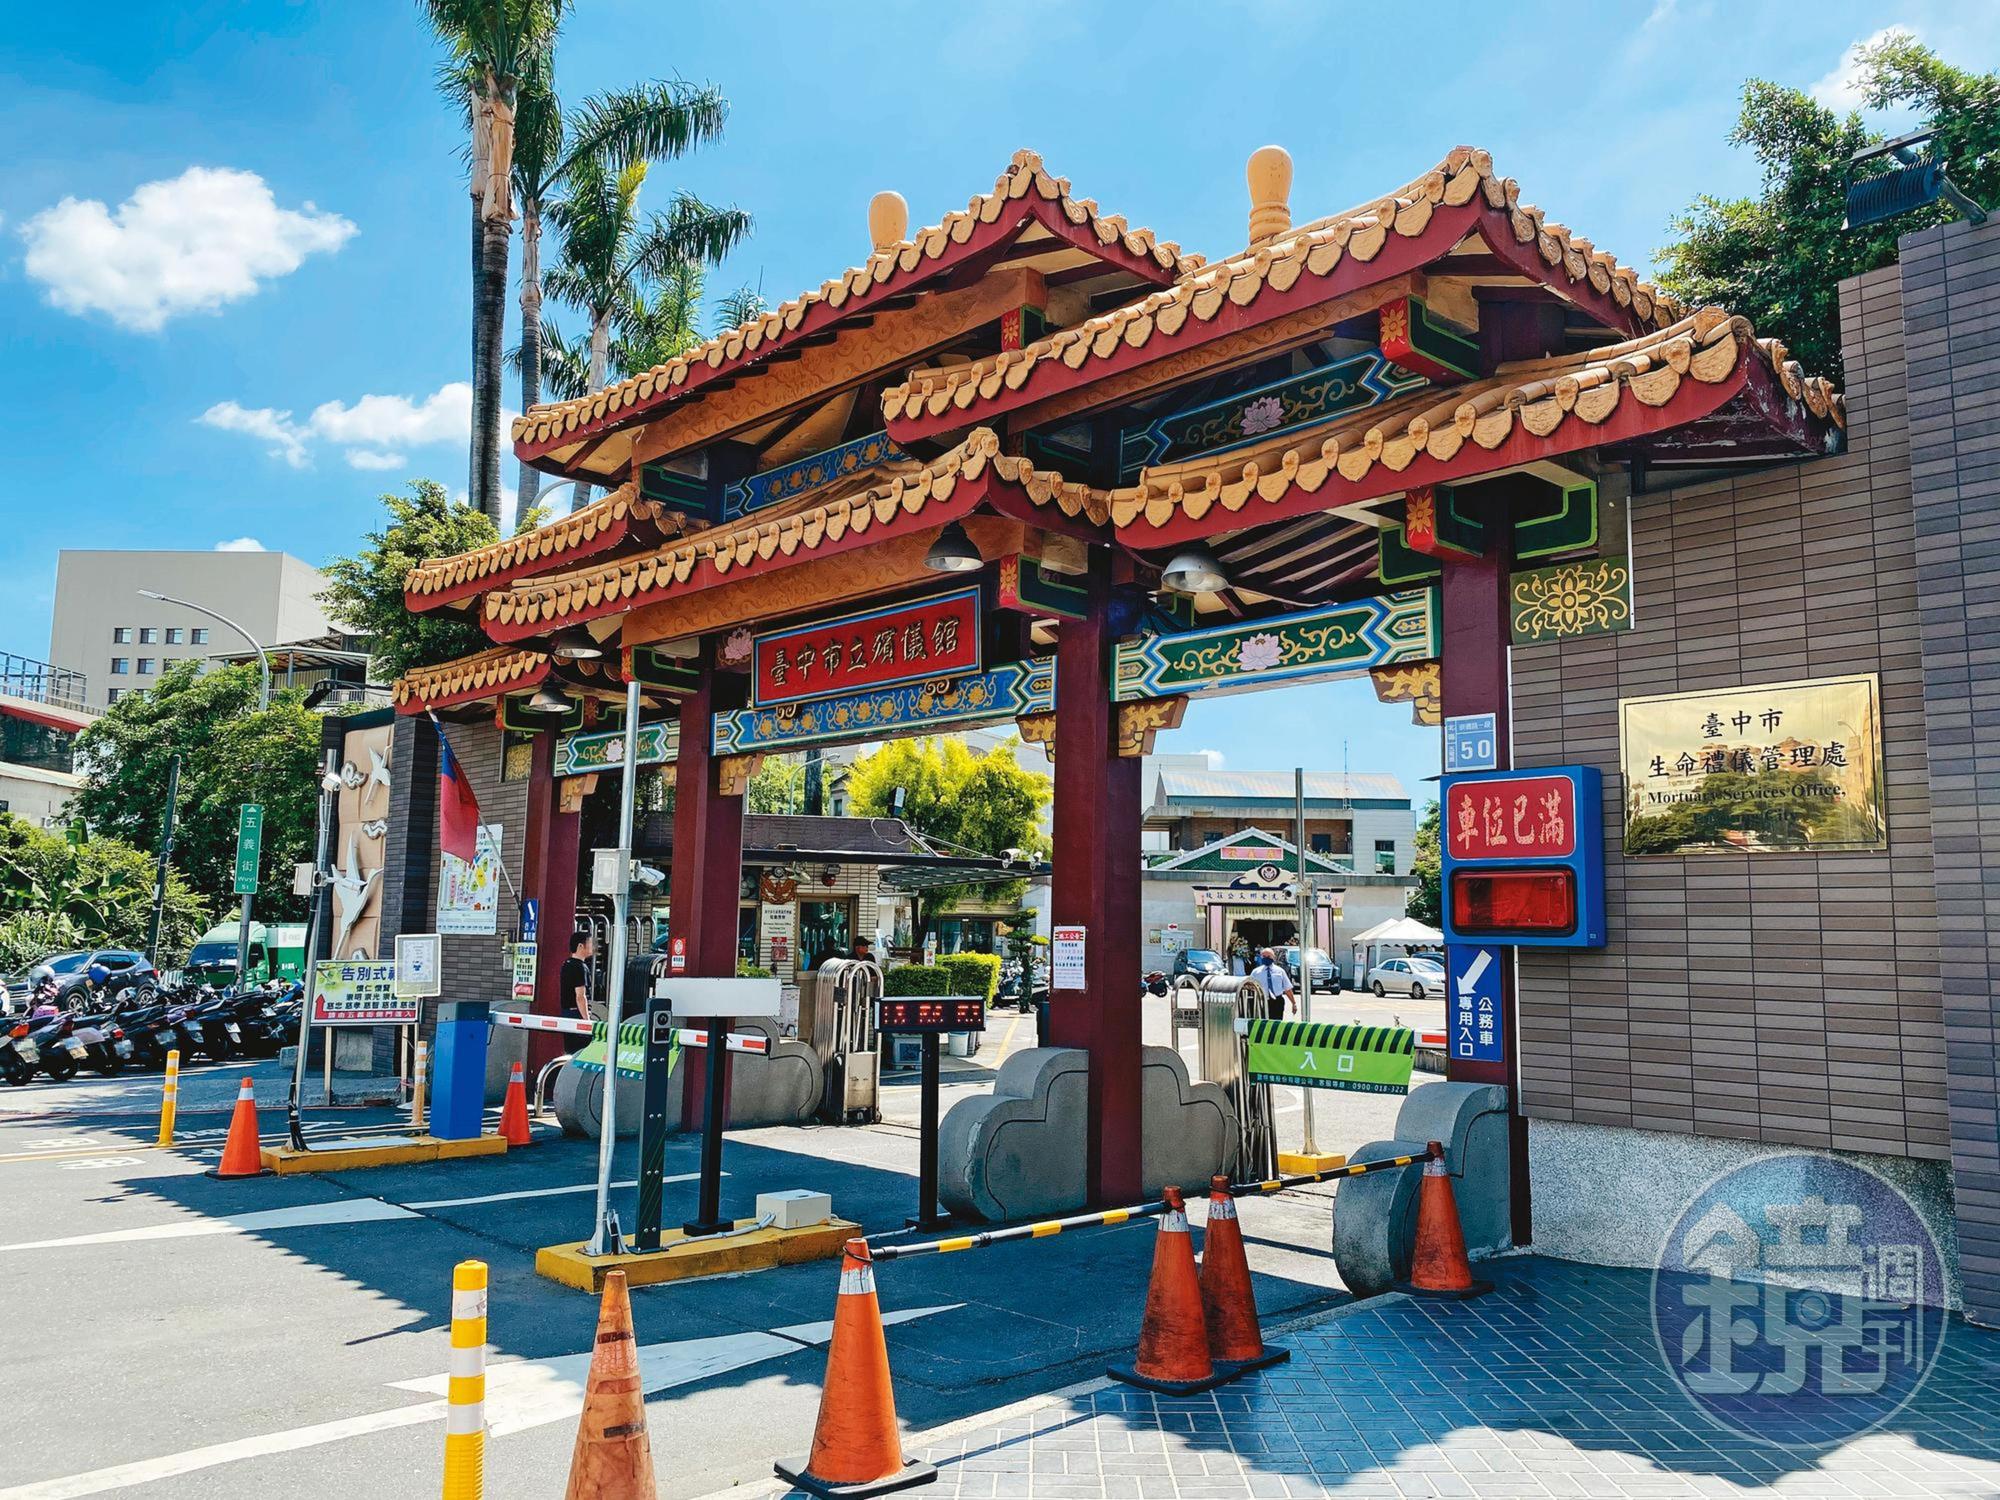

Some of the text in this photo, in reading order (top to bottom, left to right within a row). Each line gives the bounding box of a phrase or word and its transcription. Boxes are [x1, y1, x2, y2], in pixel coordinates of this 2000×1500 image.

[769, 616, 961, 688] 臺中市立殯儀館
[1700, 707, 1784, 739] 臺中市
[1461, 739, 1491, 760] 50
[1647, 740, 1850, 778] 生命禮儀管理處
[1647, 782, 1847, 806] Mortuary Services Office,
[1456, 788, 1565, 851] 車位已滿
[242, 816, 257, 872] 五義街
[1458, 995, 1474, 1057] 專用入口
[1478, 996, 1494, 1046] 公務車
[1300, 1051, 1354, 1073] 入口
